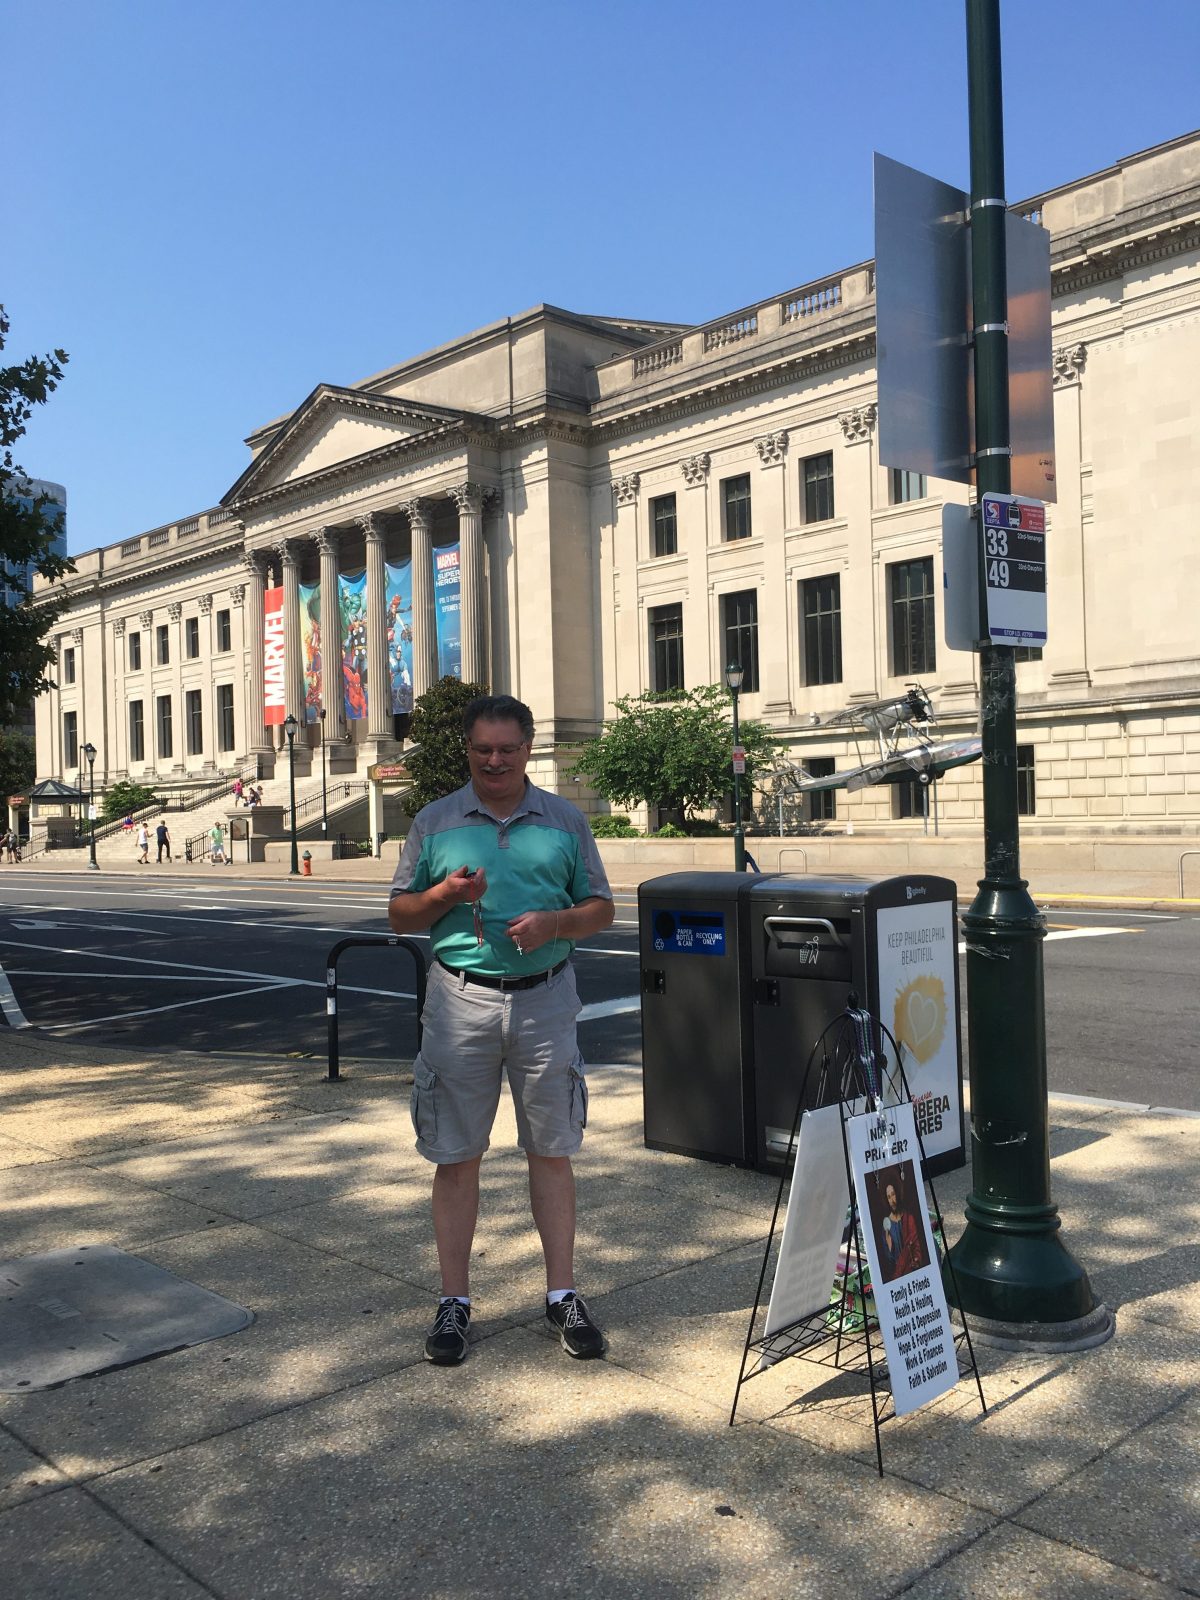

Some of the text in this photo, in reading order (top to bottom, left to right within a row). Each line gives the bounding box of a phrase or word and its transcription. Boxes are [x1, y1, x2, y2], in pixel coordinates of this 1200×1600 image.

[987, 529, 1009, 557] 33
[437, 553, 459, 569] MARVEL
[437, 569, 460, 581] SUPER
[989, 560, 1010, 588] 49
[264, 604, 285, 707] MARVEL
[887, 926, 946, 949] KEEP PHILADELPHIA
[901, 947, 934, 966] BEAUTIFUL
[890, 1276, 930, 1304] Family & Friends
[894, 1294, 934, 1320] Health & Healing
[893, 1307, 942, 1340] Anxiety & Depression
[897, 1325, 944, 1357] Hope & Forgiveness
[905, 1342, 944, 1372] Work & Finances
[908, 1360, 948, 1390] Faith & Salvation
